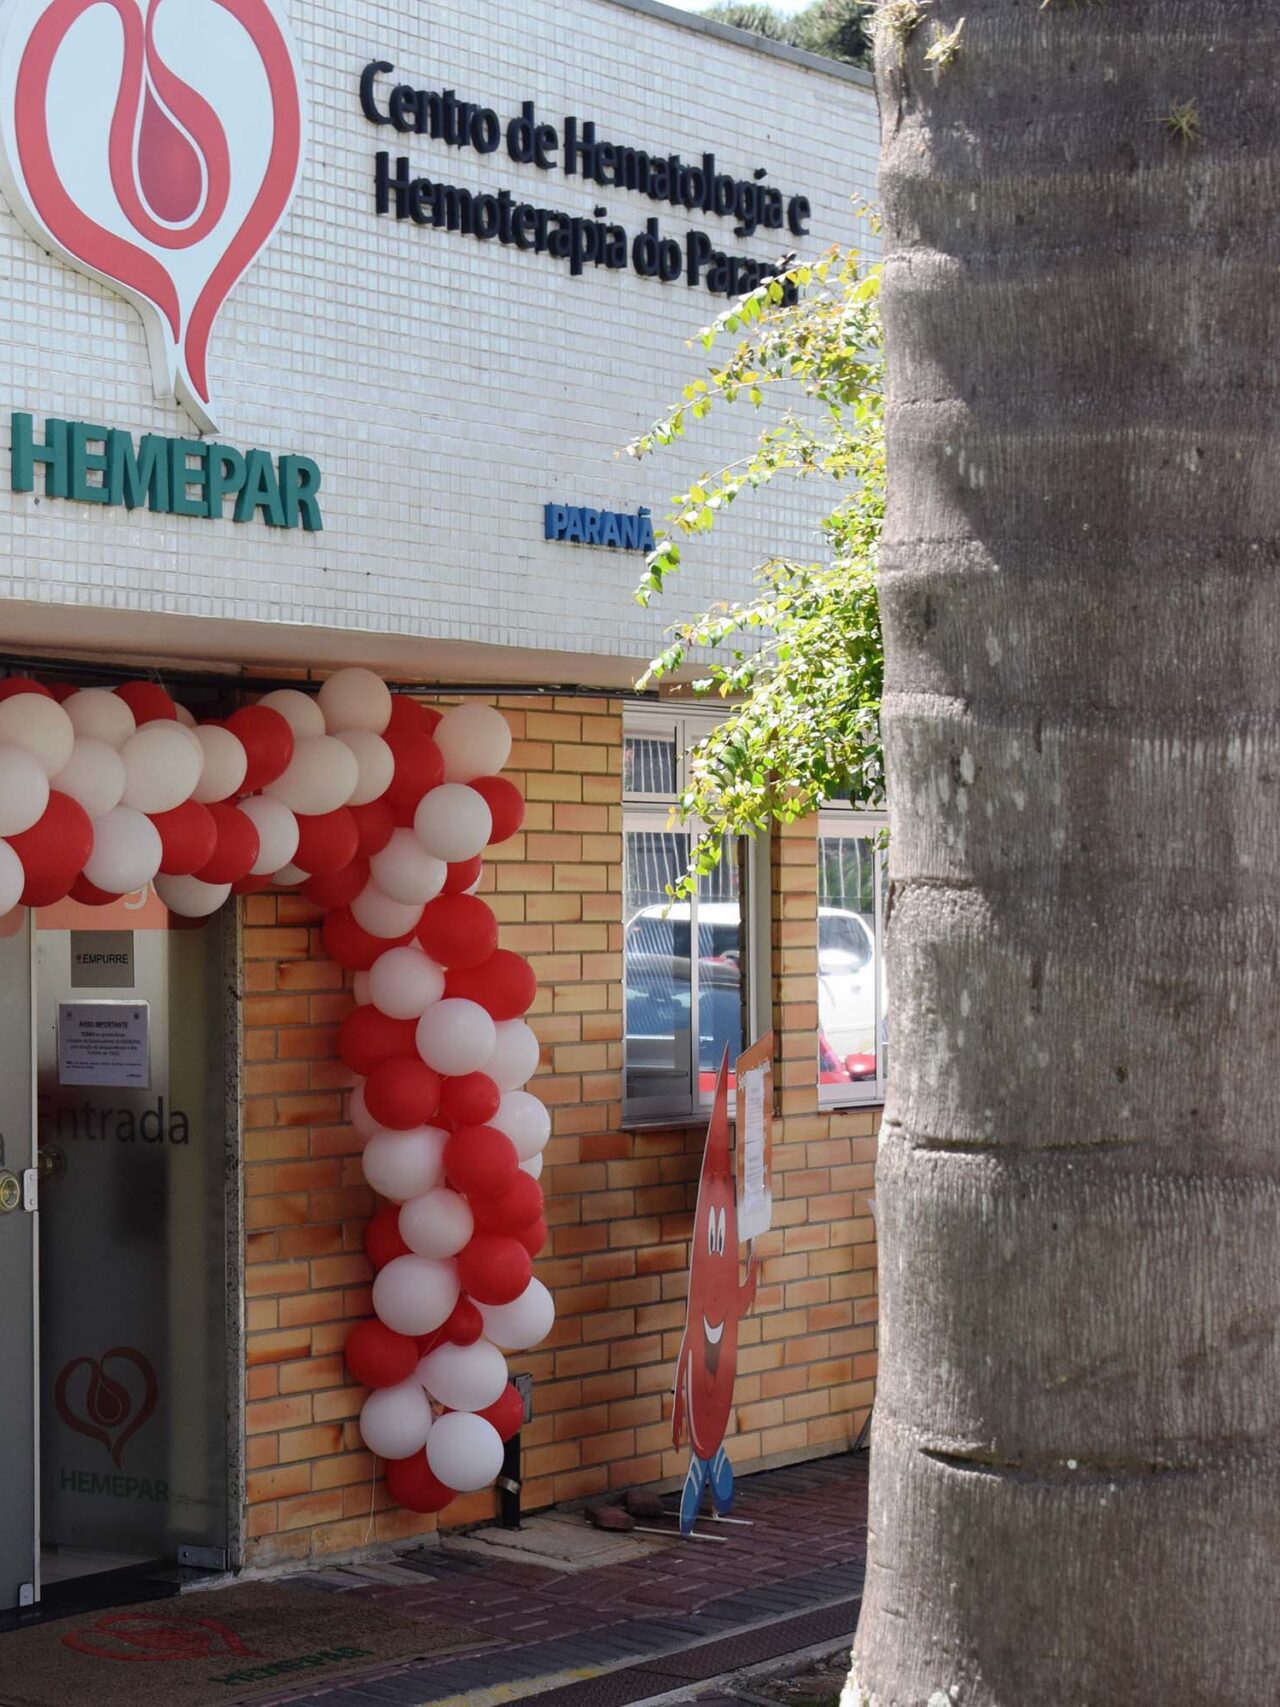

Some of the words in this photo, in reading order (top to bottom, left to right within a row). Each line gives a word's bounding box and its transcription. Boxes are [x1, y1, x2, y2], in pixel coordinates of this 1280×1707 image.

[360, 59, 501, 154] Centro
[507, 101, 558, 169] de
[564, 116, 784, 236] Hematologia
[788, 192, 810, 236] e
[375, 151, 627, 276] Hemoterapia
[632, 217, 682, 282] do
[11, 412, 323, 531] HEMEPAR
[82, 953, 129, 965] EMPURRE
[59, 1468, 170, 1500] HEMEPAR
